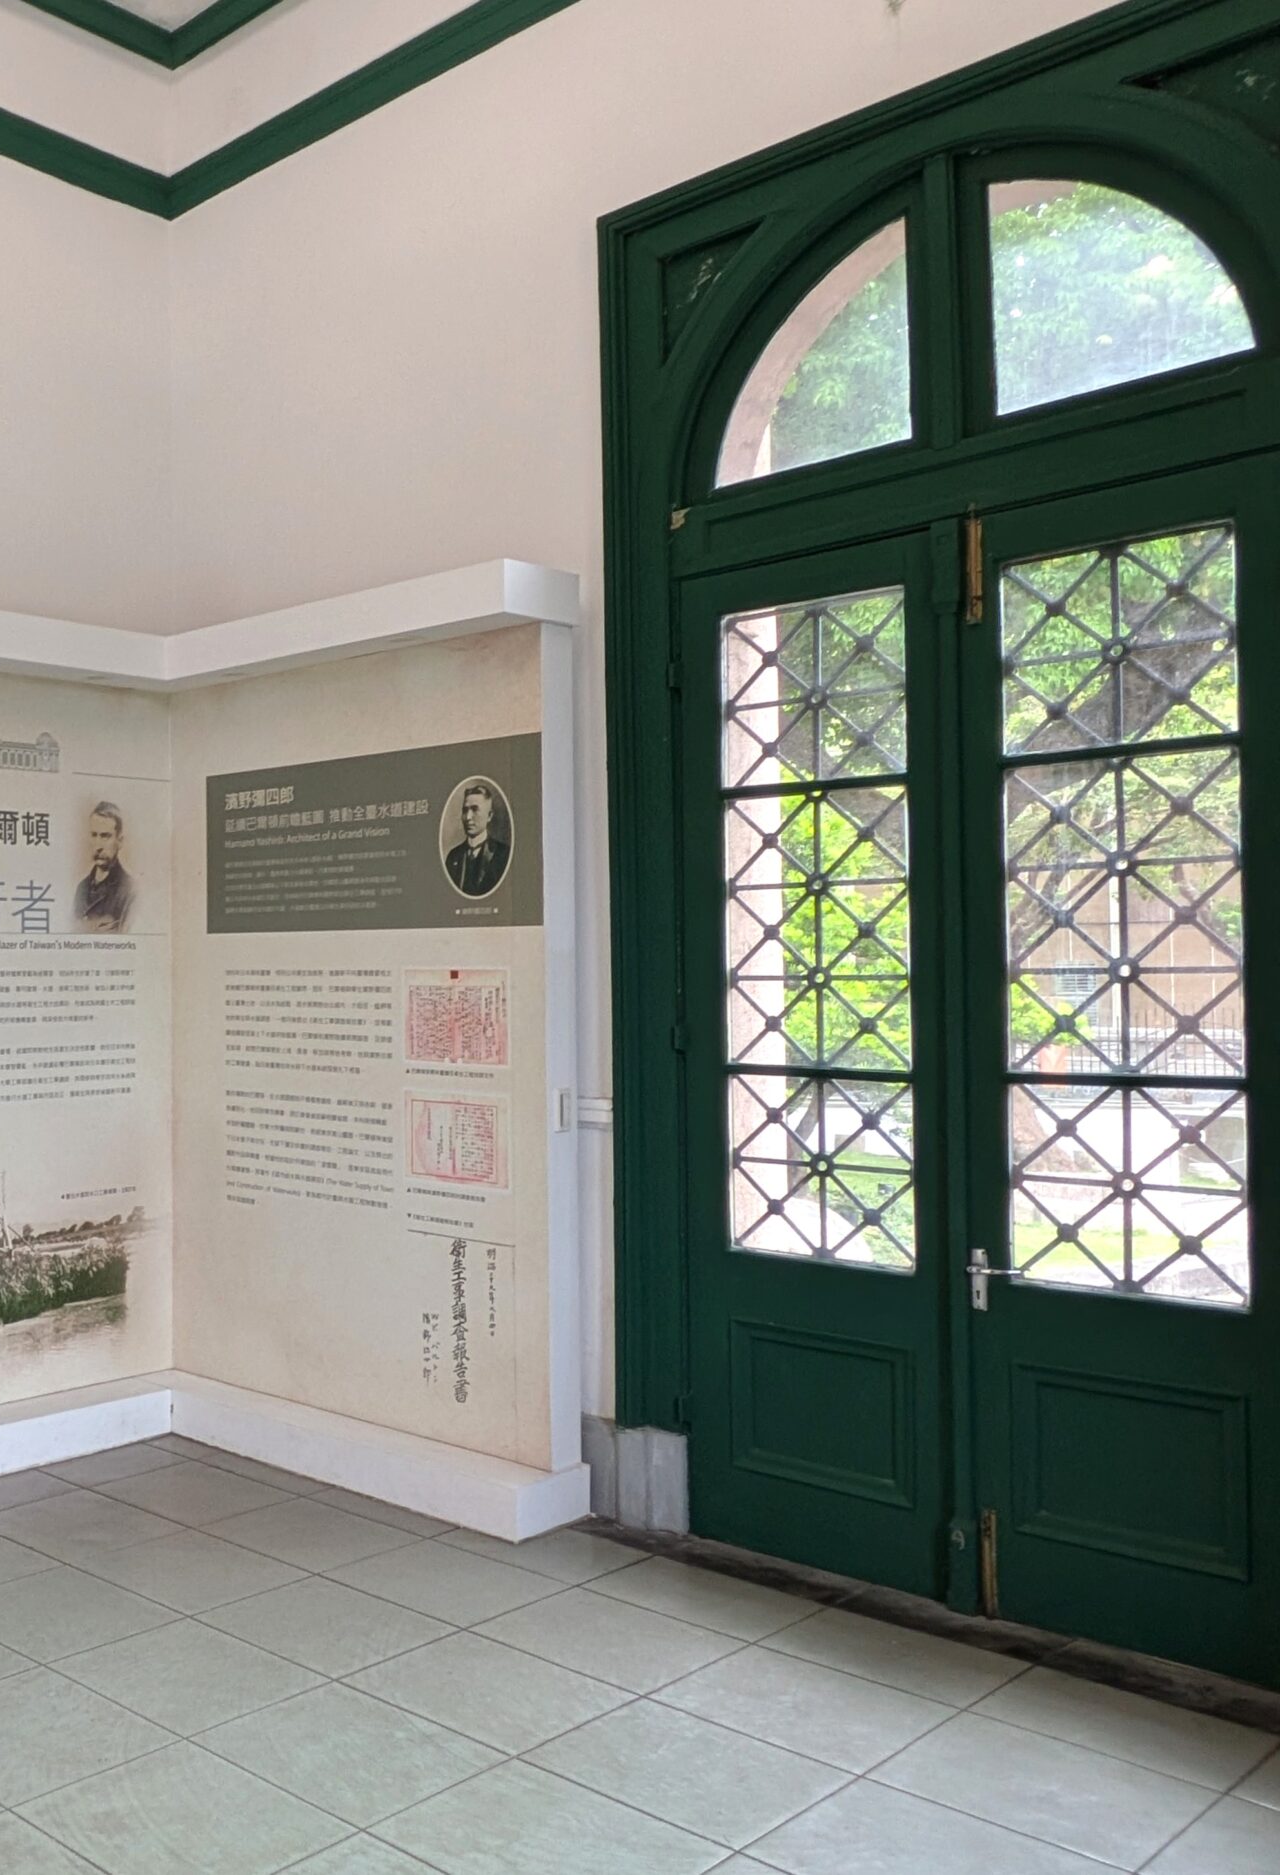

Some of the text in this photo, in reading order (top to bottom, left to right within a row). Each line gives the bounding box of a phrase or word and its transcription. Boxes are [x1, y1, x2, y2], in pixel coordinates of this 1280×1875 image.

[321, 830, 330, 841] of
[338, 828, 362, 840] Grand
[364, 826, 390, 838] Vision
[19, 940, 27, 950] of
[64, 940, 92, 950] Modern
[93, 940, 136, 950] Waterworks
